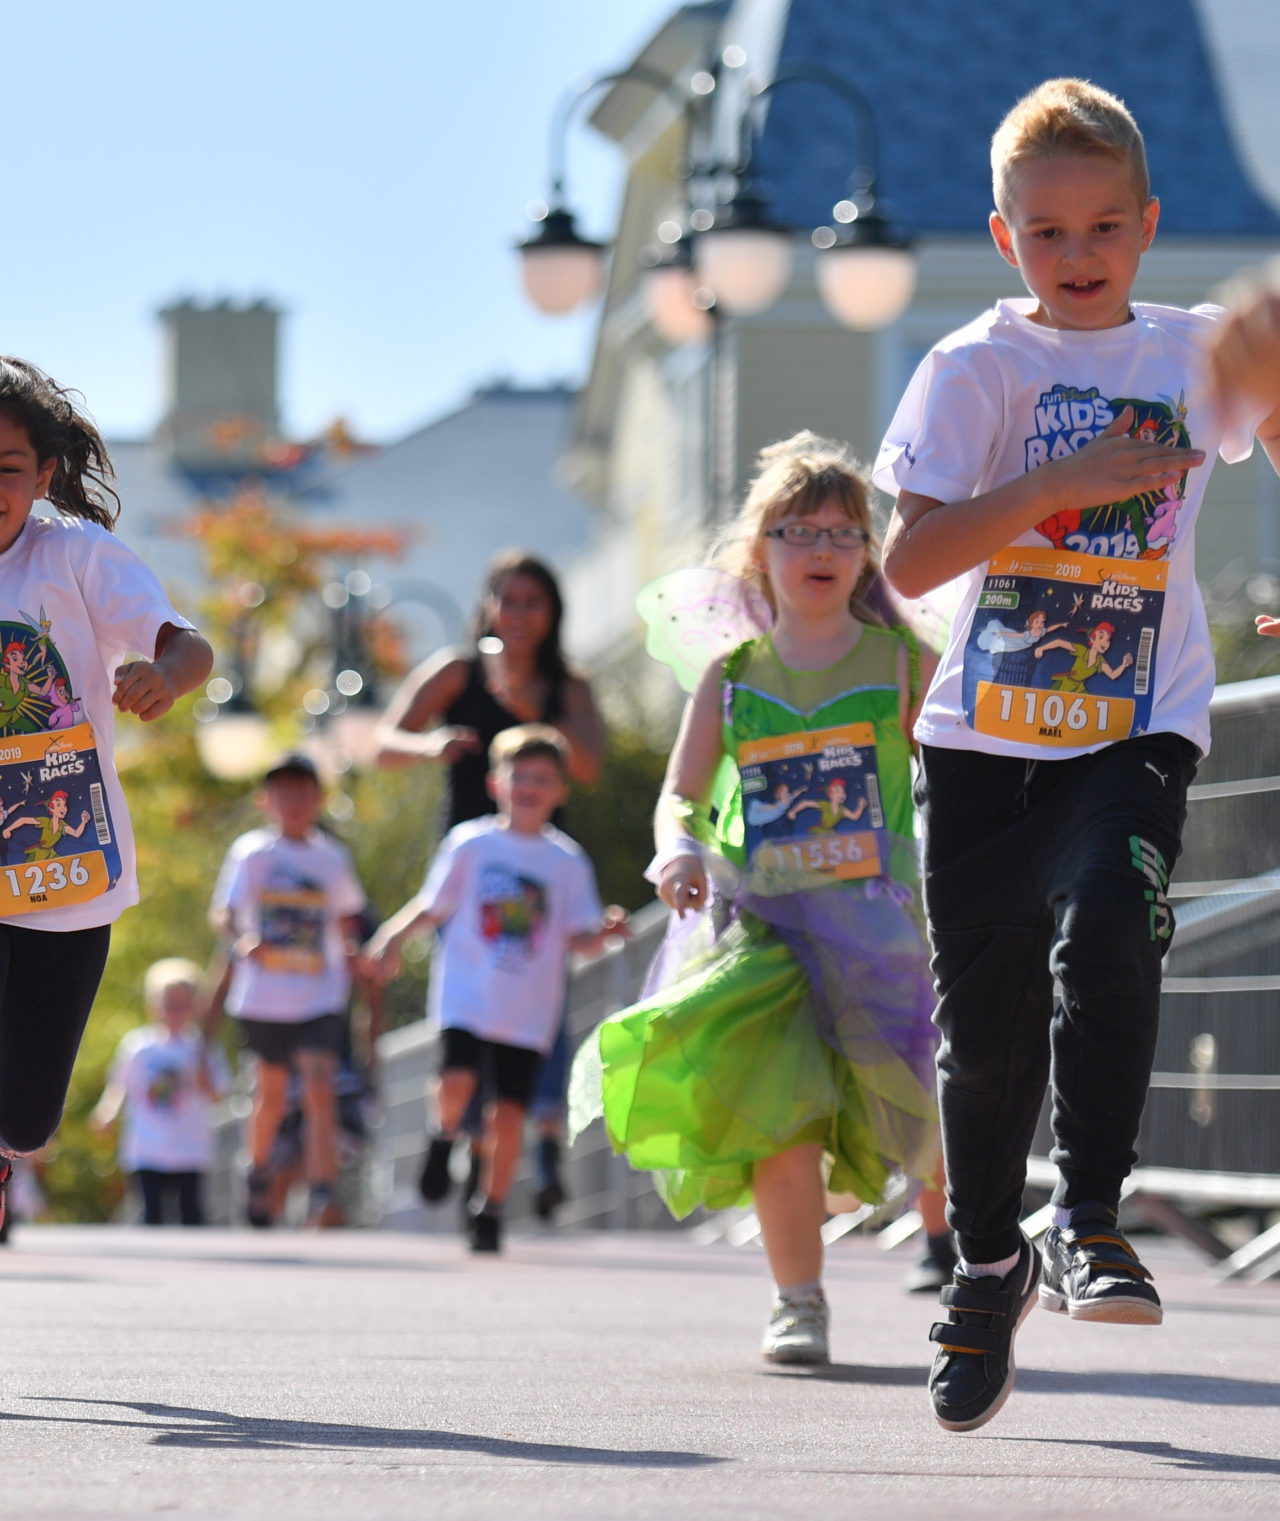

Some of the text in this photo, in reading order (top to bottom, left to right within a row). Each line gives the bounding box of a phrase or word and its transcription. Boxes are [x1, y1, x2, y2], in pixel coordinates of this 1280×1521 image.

[1035, 397, 1114, 437] KIDS
[1025, 429, 1114, 473] RAC
[1064, 532, 1141, 558] 2019
[1056, 563, 1082, 579] 2019
[988, 578, 1017, 590] 11061
[1101, 580, 1141, 598] KIDS
[984, 594, 1013, 607] 200m
[1090, 594, 1145, 613] RACES
[1000, 688, 1110, 731] 11061
[44, 750, 78, 767] KIDS
[38, 759, 86, 783] RACES
[773, 838, 863, 873] 11556
[29, 893, 49, 904] NOA
